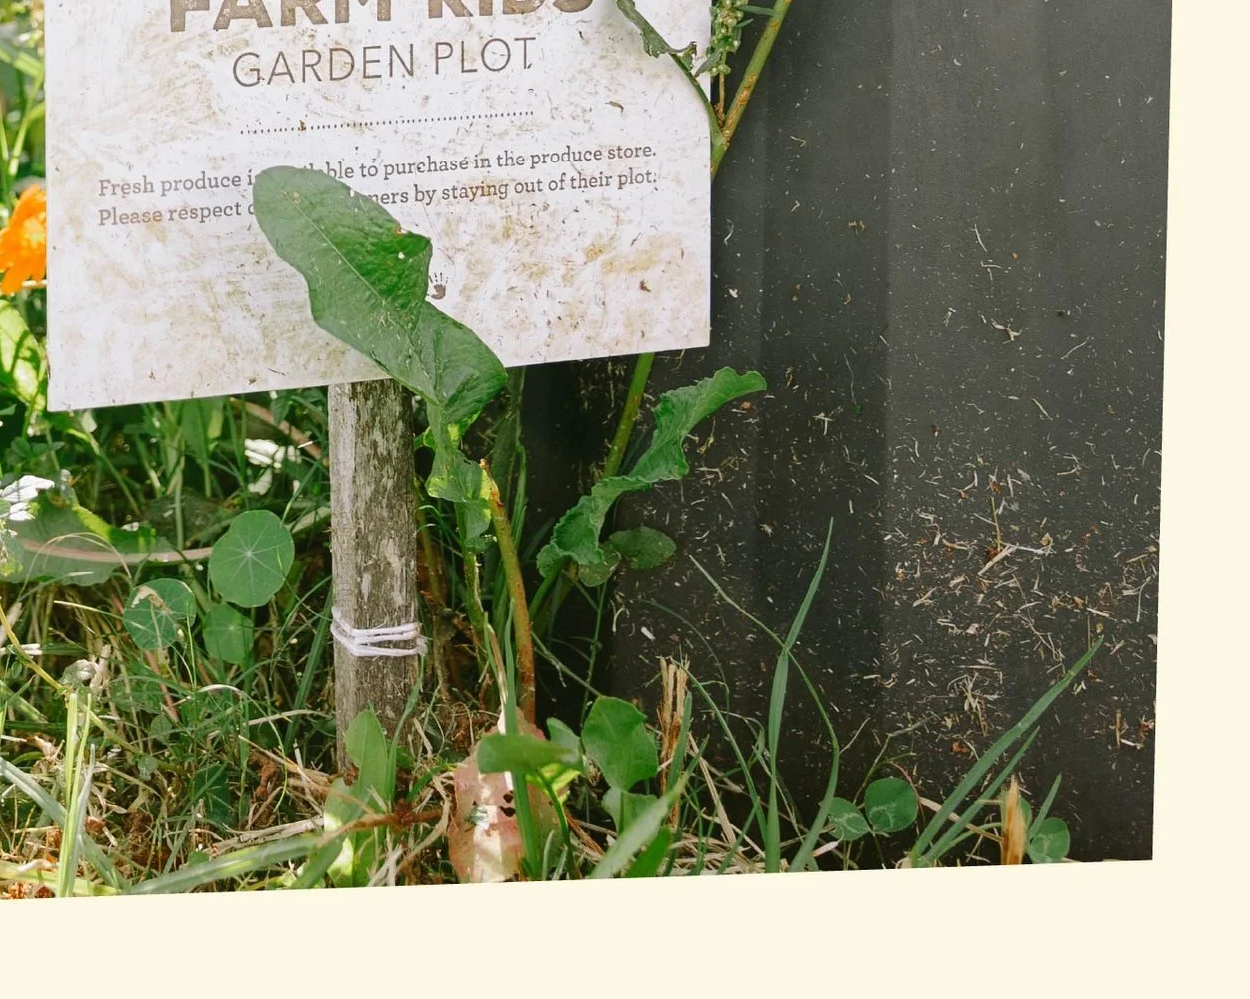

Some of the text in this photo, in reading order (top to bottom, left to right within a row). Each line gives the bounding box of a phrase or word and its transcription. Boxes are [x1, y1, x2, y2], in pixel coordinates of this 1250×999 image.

[232, 37, 536, 87] GARDEN PLOT
[98, 175, 154, 197] Fresh
[161, 171, 241, 197] produce
[360, 163, 378, 178] to
[384, 154, 469, 180] purchase
[474, 155, 492, 169] in
[497, 151, 525, 167] the
[530, 145, 603, 169] produce
[607, 145, 656, 160] store.
[98, 207, 163, 226] Please
[168, 202, 242, 223] respect
[414, 184, 436, 206] by
[442, 181, 508, 200] staying
[514, 176, 543, 194] out
[547, 172, 566, 191] of
[570, 171, 612, 189] their
